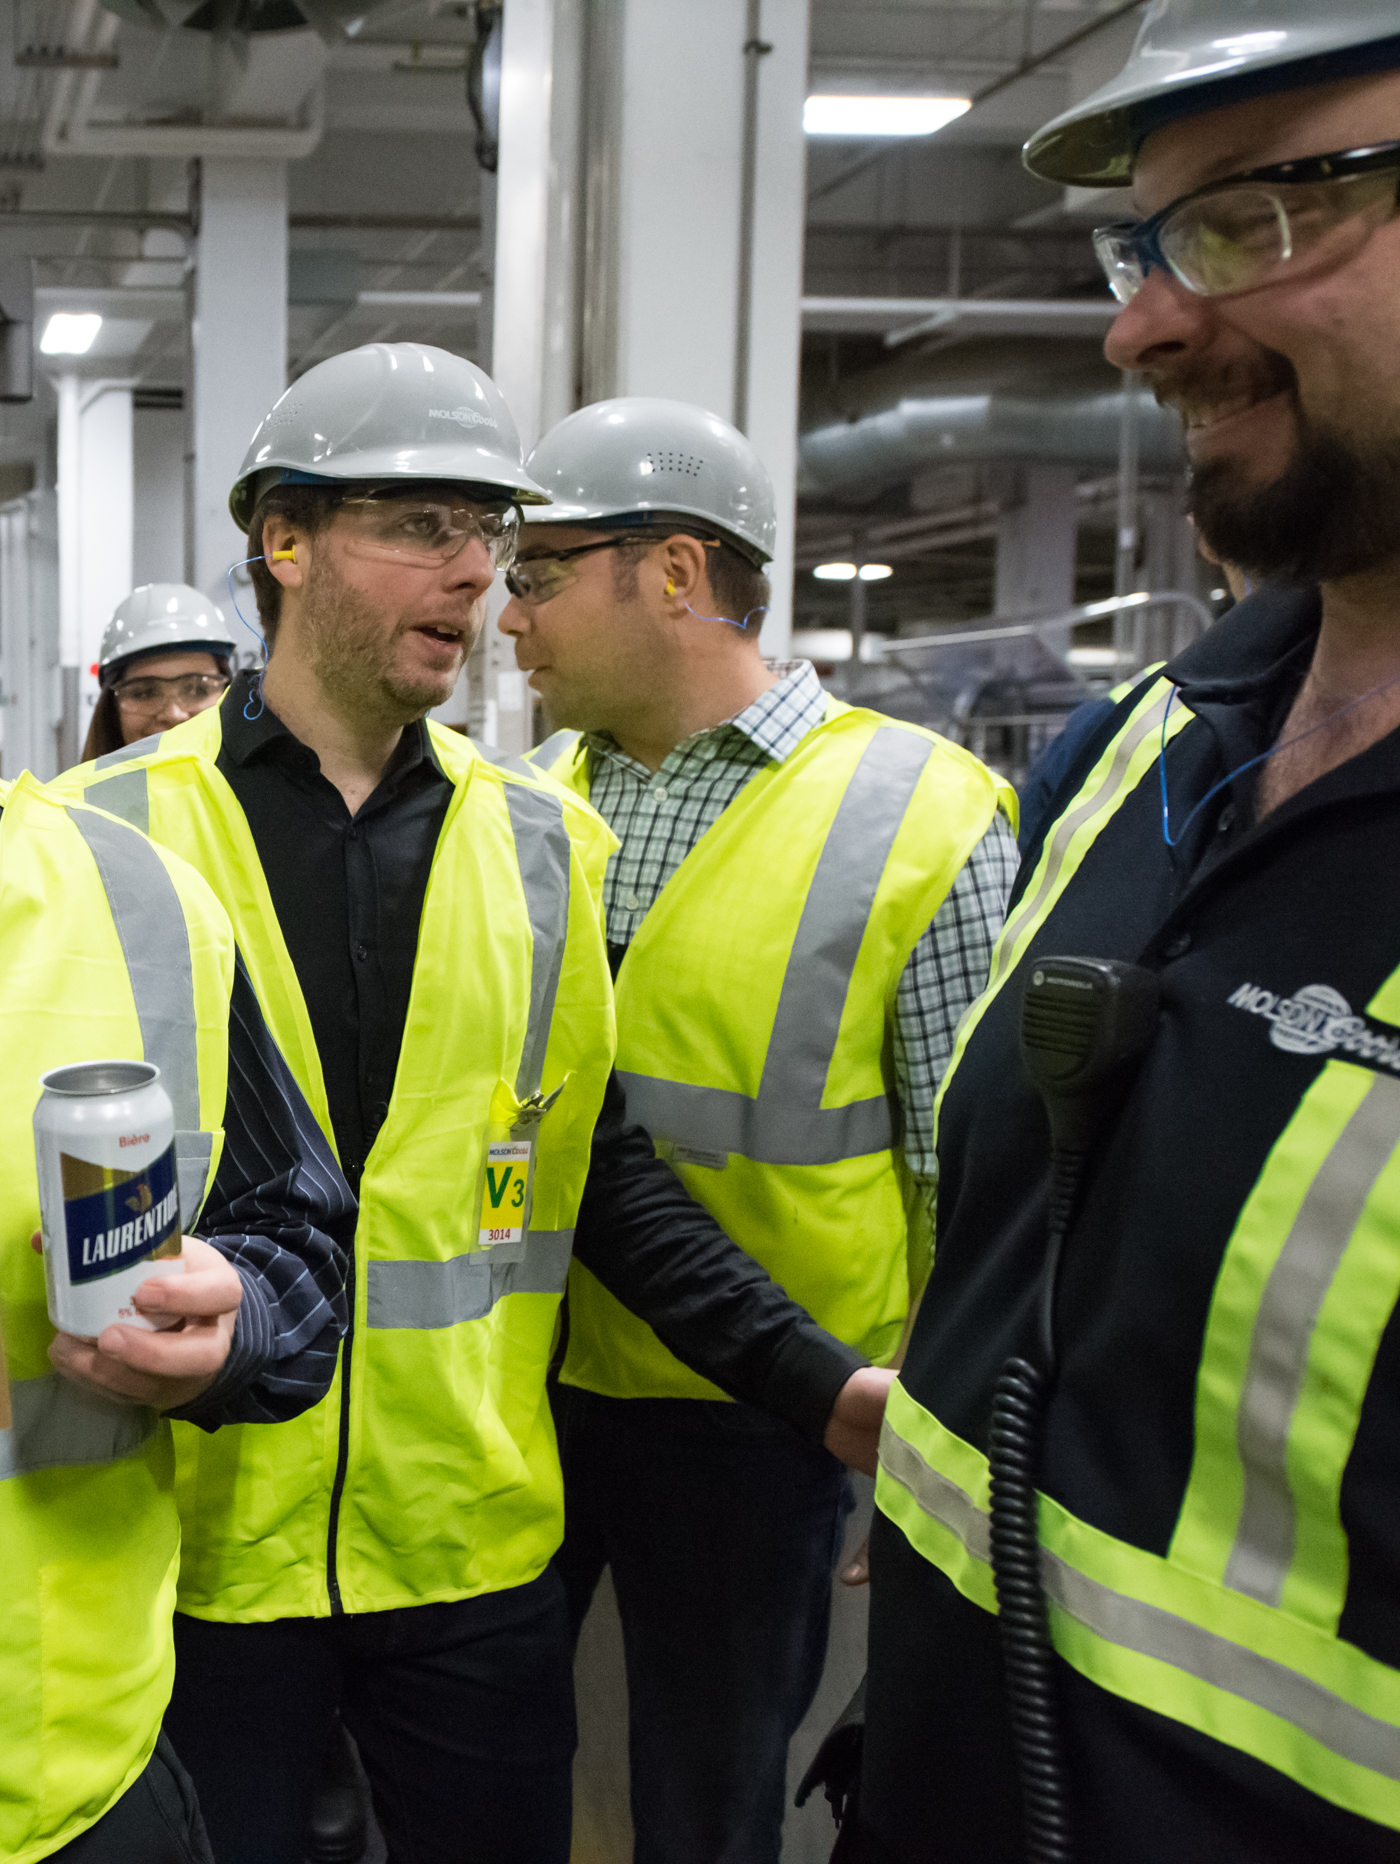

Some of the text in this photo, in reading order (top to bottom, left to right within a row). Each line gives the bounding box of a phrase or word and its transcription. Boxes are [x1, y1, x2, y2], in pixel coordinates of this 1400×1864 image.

[428, 408, 473, 421] MOLSON
[1226, 981, 1327, 1034] MOLSON
[118, 1133, 150, 1149] Bière
[489, 1148, 511, 1156] MOLSON
[488, 1228, 511, 1241] 3014
